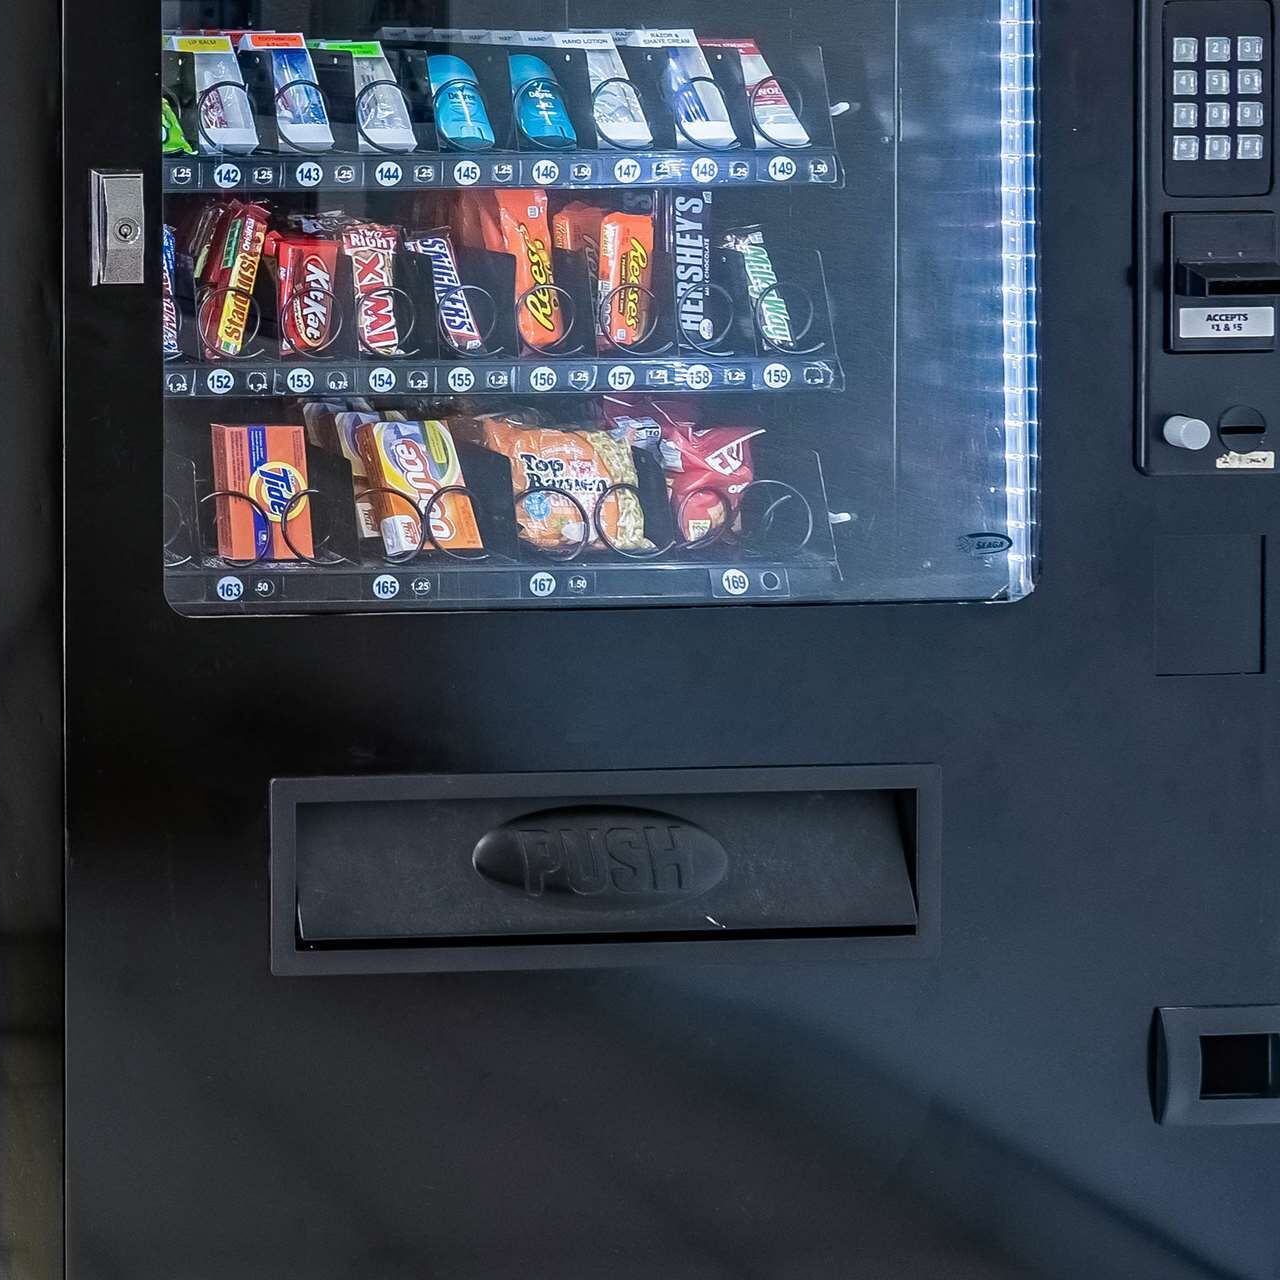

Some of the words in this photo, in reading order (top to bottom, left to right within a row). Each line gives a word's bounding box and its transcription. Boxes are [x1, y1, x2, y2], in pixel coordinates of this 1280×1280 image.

[172, 168, 192, 178] 1.25
[216, 168, 238, 183] 142
[253, 170, 273, 180] 1.25
[298, 167, 321, 182] 143
[335, 169, 353, 180] 1.25
[377, 166, 400, 181] 144
[414, 168, 433, 178] 1.25
[456, 166, 477, 180] 145
[494, 164, 513, 175] 1.25
[534, 164, 557, 179] 146
[573, 167, 592, 177] 1.50
[616, 164, 638, 178] 147
[694, 163, 715, 177] 148
[771, 161, 794, 176] 149
[675, 196, 704, 332] HERSHEY'S
[1205, 313, 1249, 322] ACCEPTS
[1211, 324, 1221, 332] $1
[1223, 324, 1231, 332] &
[1233, 324, 1243, 332] $5
[208, 375, 231, 390] 152
[289, 374, 312, 388] 153
[371, 373, 392, 387] 154
[410, 378, 429, 389] 1.25
[450, 372, 472, 387] 155
[490, 374, 509, 385] 1.25
[532, 372, 555, 386] 156
[569, 371, 589, 382] 1.25
[610, 371, 632, 385] 157
[766, 370, 788, 384] 159
[520, 453, 564, 477] Top
[258, 467, 294, 515] Tide
[375, 580, 397, 595] 165
[410, 581, 430, 592] 1.25
[532, 577, 553, 591] 167
[568, 579, 587, 589] 1.50
[724, 574, 747, 589] 169
[219, 582, 241, 598] 163
[518, 826, 690, 897] PUSH
